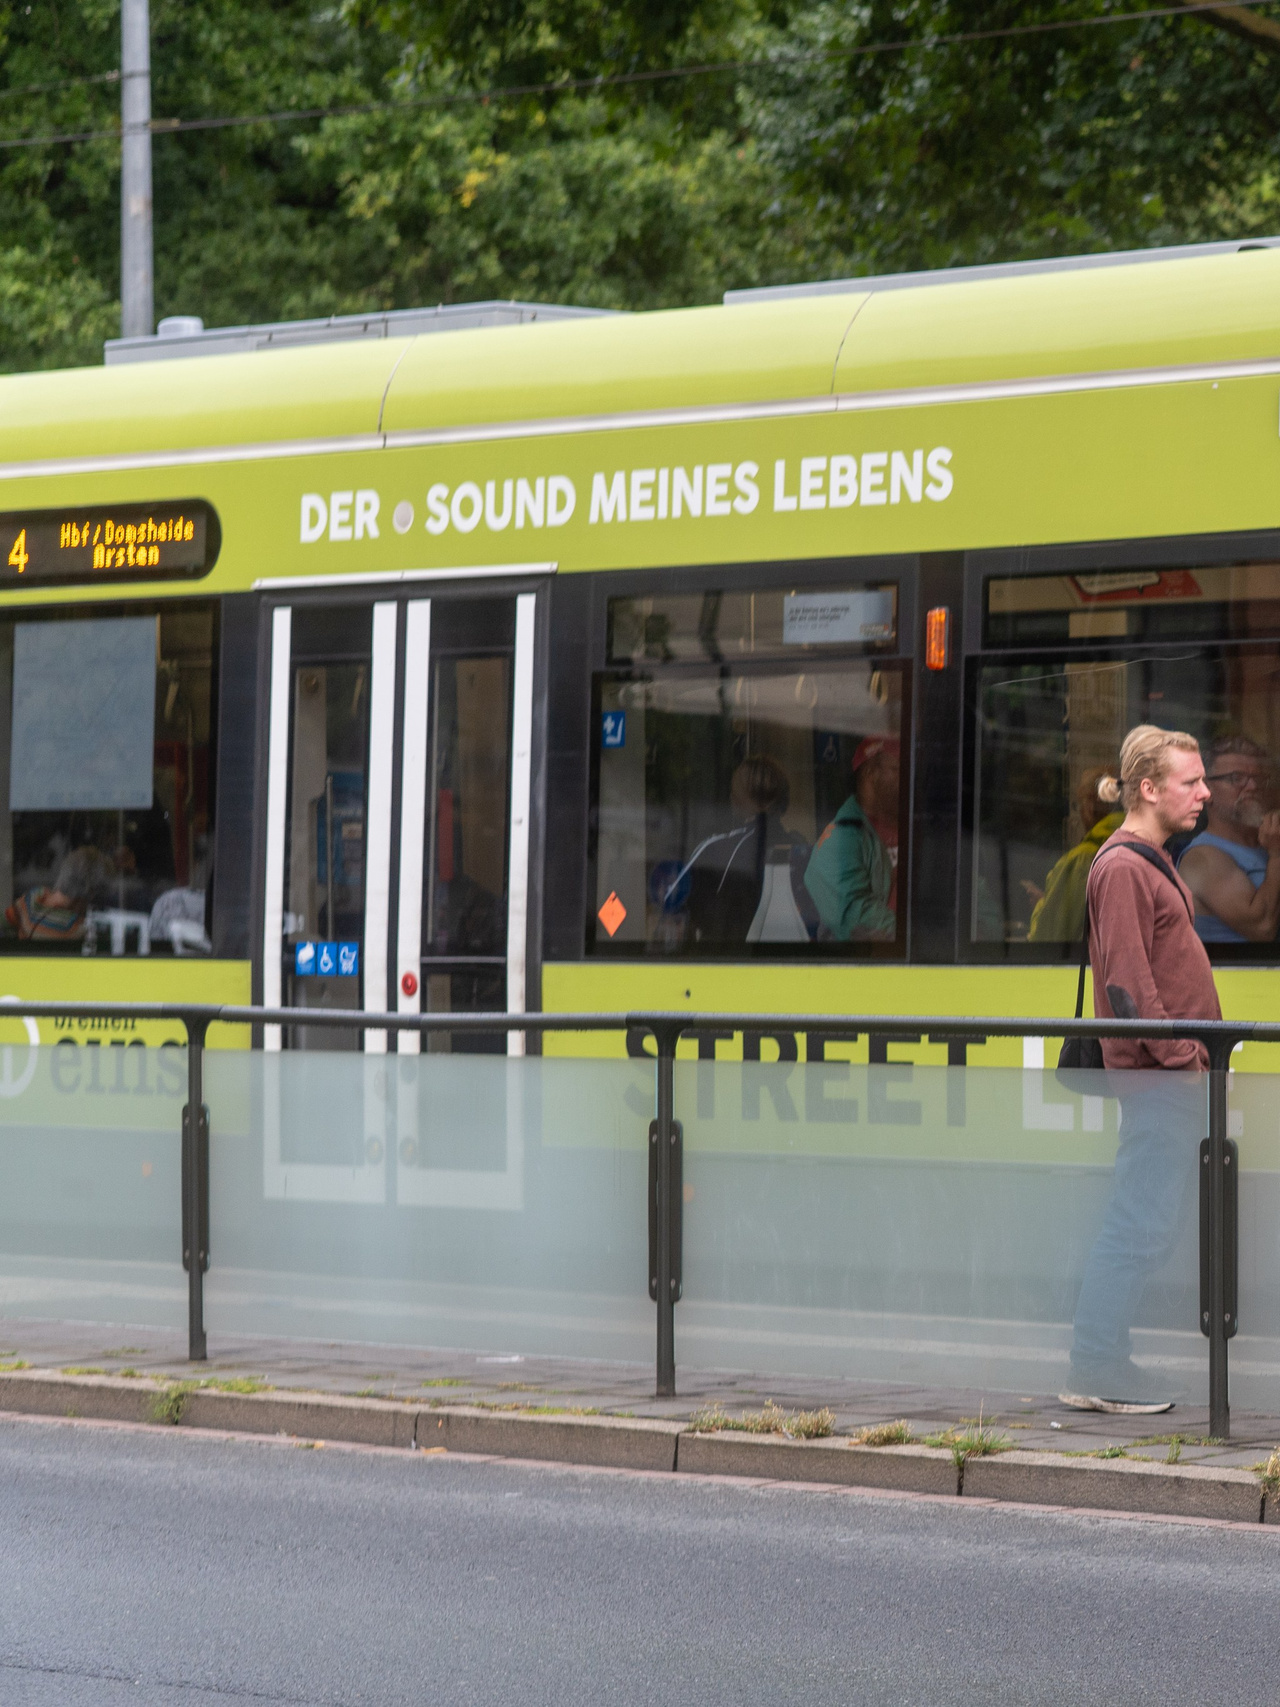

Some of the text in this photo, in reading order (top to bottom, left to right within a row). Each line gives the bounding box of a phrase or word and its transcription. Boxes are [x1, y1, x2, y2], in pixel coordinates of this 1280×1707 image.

[300, 446, 955, 543] DER SOUND MEINES LEBENS
[8, 528, 29, 573] 4
[92, 542, 160, 569] Arsten
[623, 1031, 987, 1128] STREET
